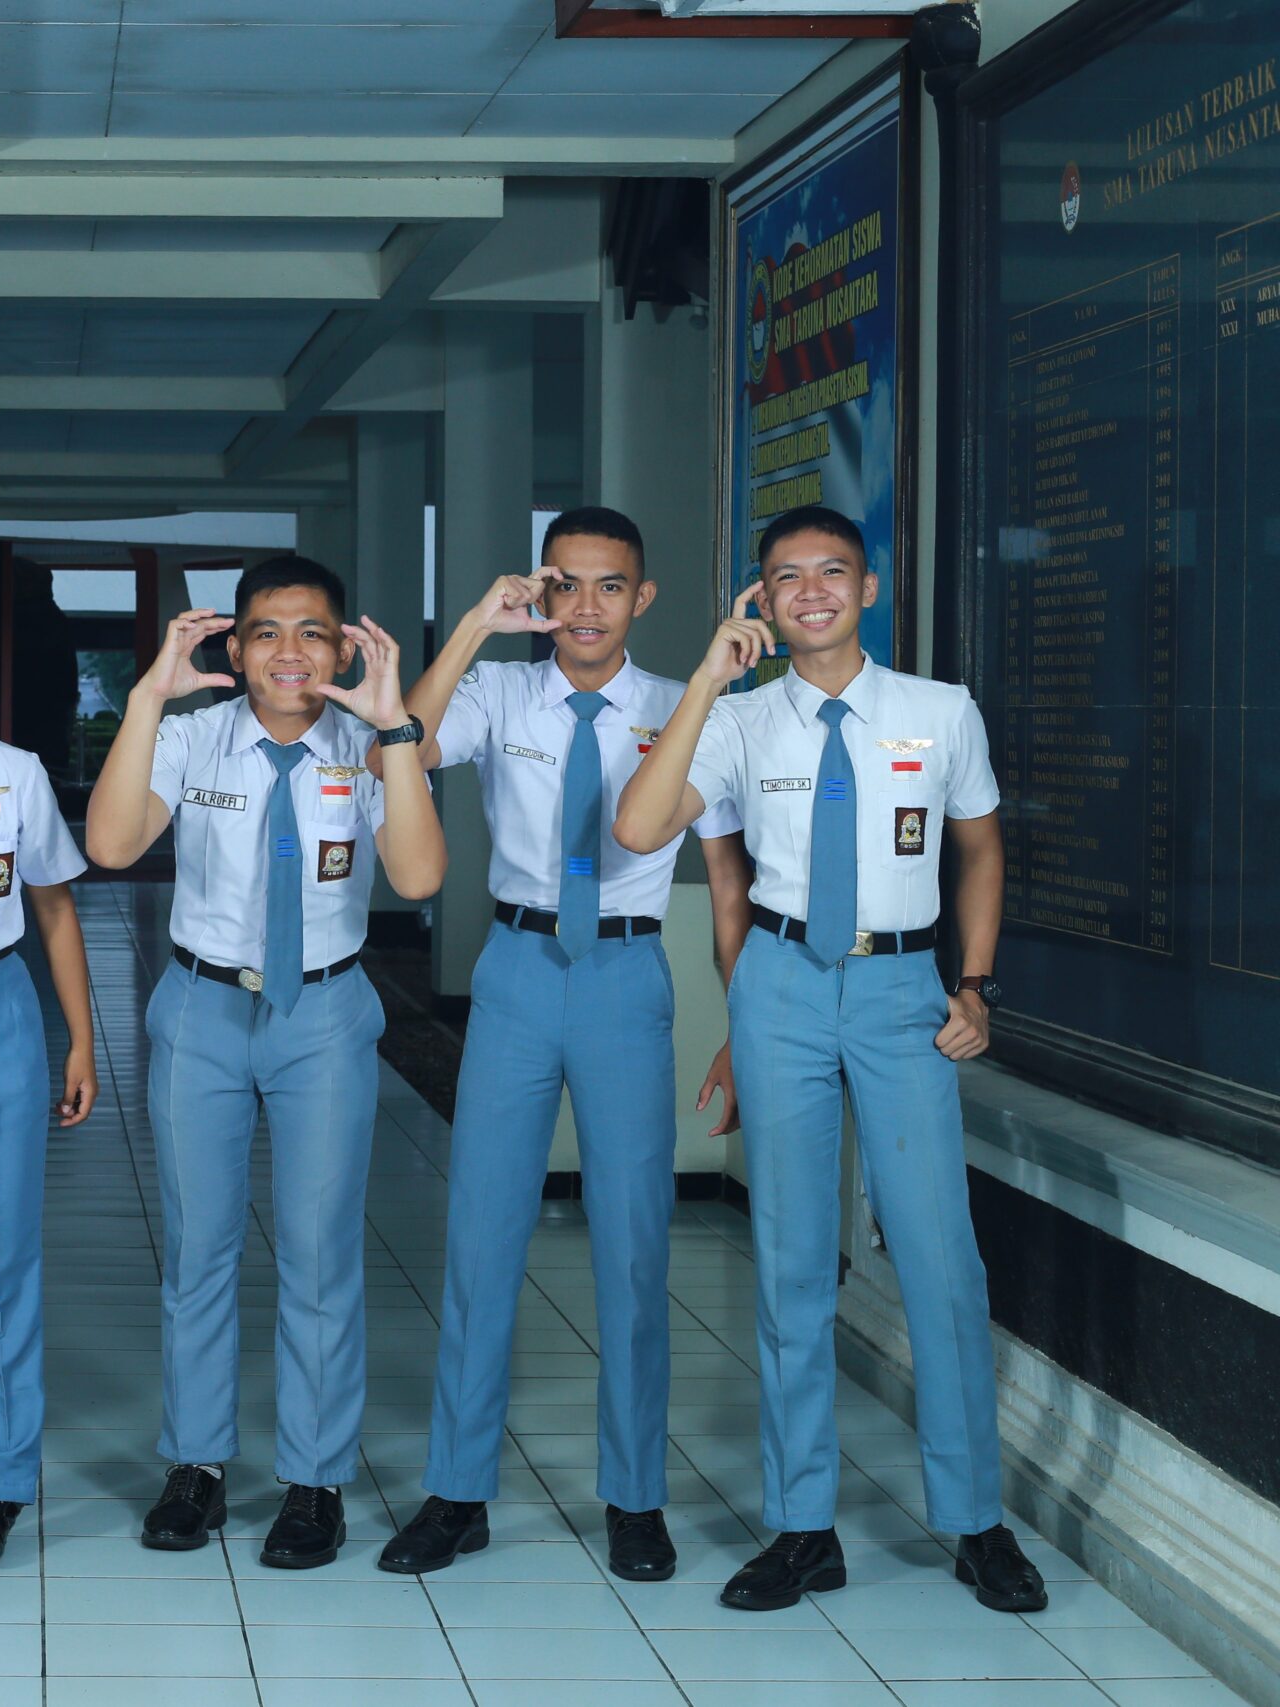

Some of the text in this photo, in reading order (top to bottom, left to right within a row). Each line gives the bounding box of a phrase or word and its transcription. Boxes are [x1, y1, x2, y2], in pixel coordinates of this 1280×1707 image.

[1127, 58, 1276, 161] LULUSAN TERBAIK
[1104, 173, 1133, 209] SMA
[1138, 142, 1199, 194] TARUNA
[773, 210, 882, 304] KODE KEHORMATAN SISWA
[774, 270, 878, 354] SMA TARUNA NUSANTARA
[1220, 297, 1237, 314] XXX
[193, 791, 237, 808] AL ROFFI
[765, 780, 795, 790] TIMOTHY
